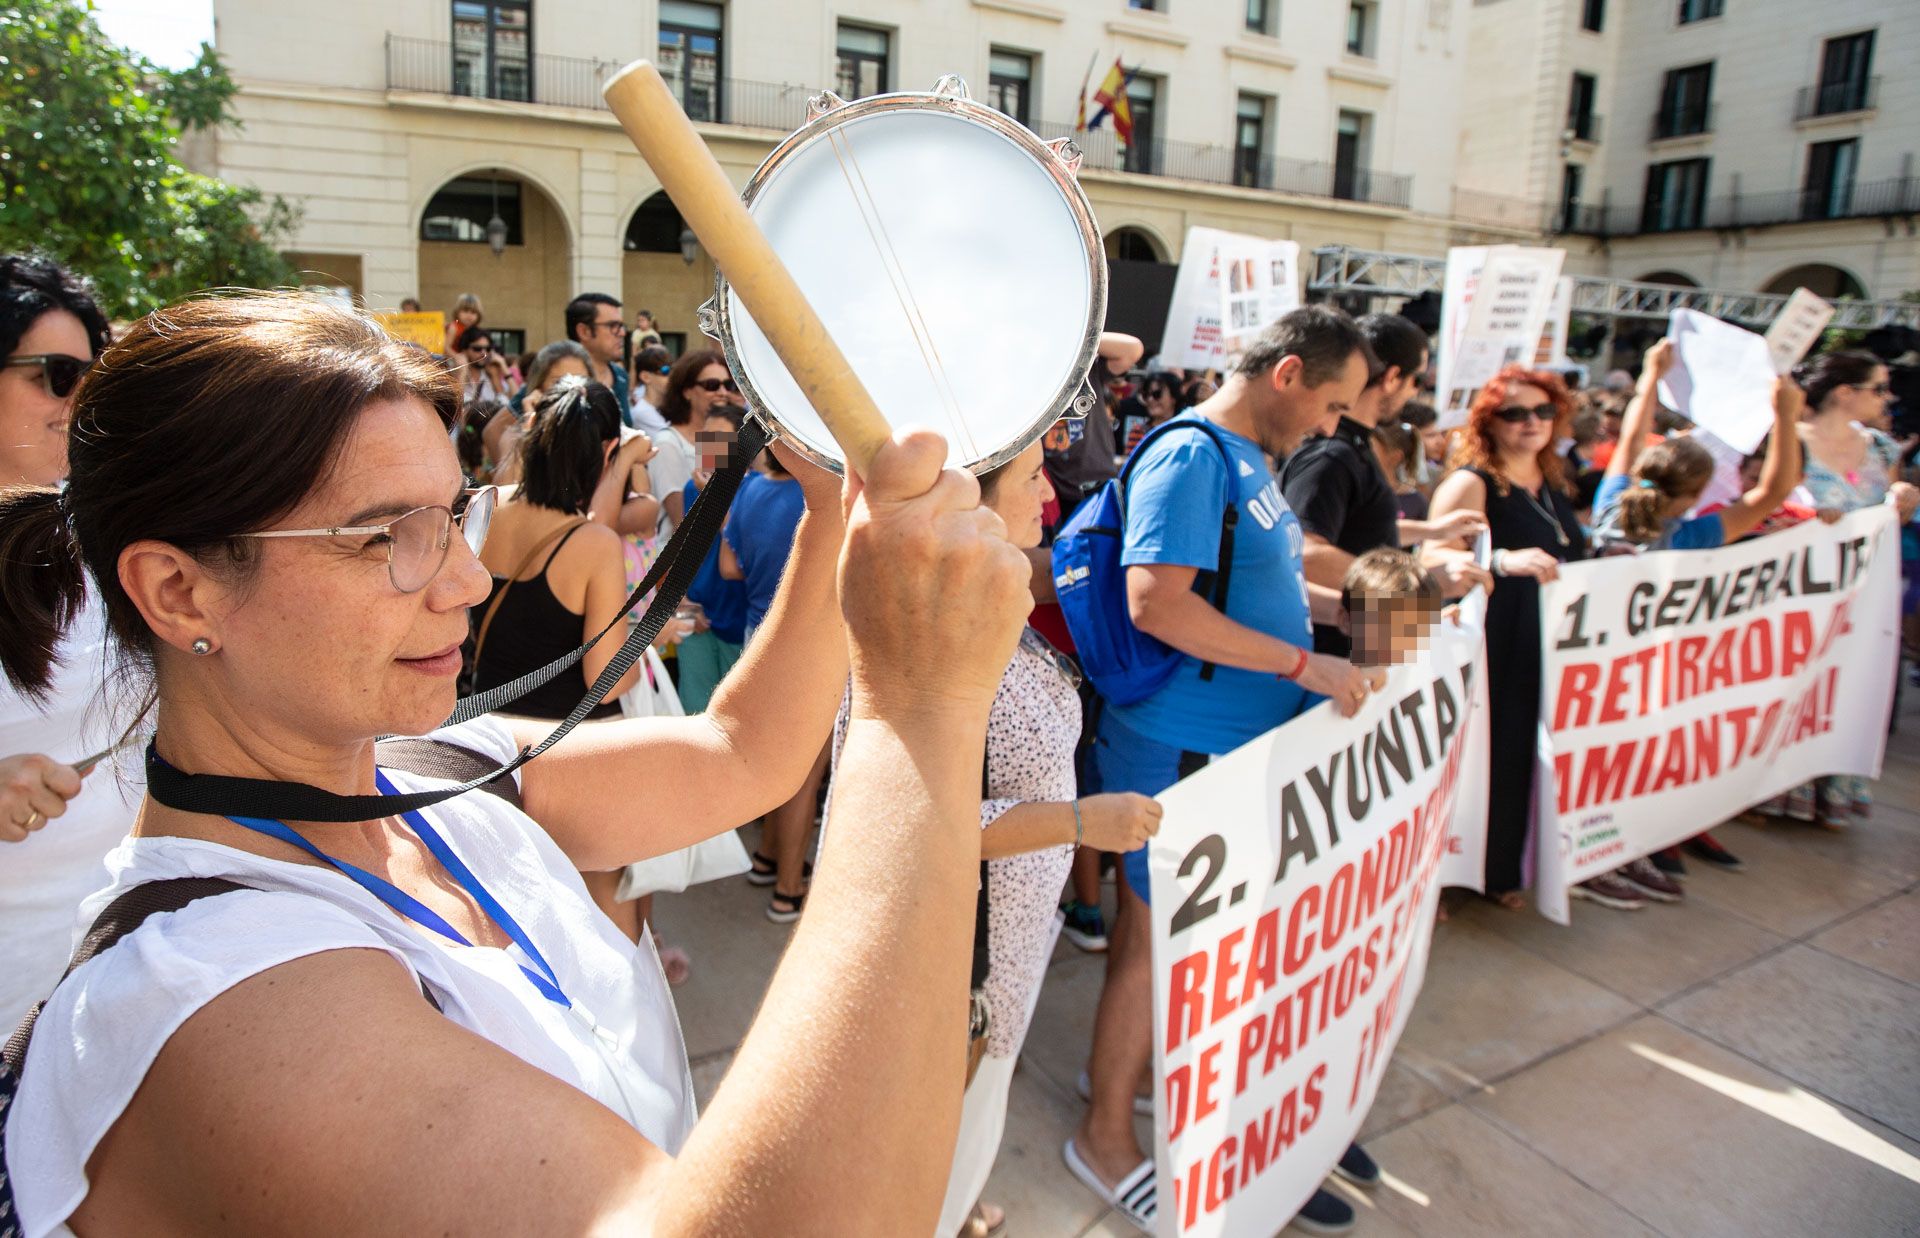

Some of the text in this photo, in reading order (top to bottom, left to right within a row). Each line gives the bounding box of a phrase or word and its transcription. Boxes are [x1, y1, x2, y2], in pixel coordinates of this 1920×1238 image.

[1555, 592, 1608, 651] 1.
[1626, 535, 1868, 638] GENERALIT
[1553, 609, 1816, 732] RETIRADA
[1170, 833, 1246, 938] 2.
[1165, 1040, 1223, 1143] DE
[1235, 923, 1383, 1097] PATIOS
